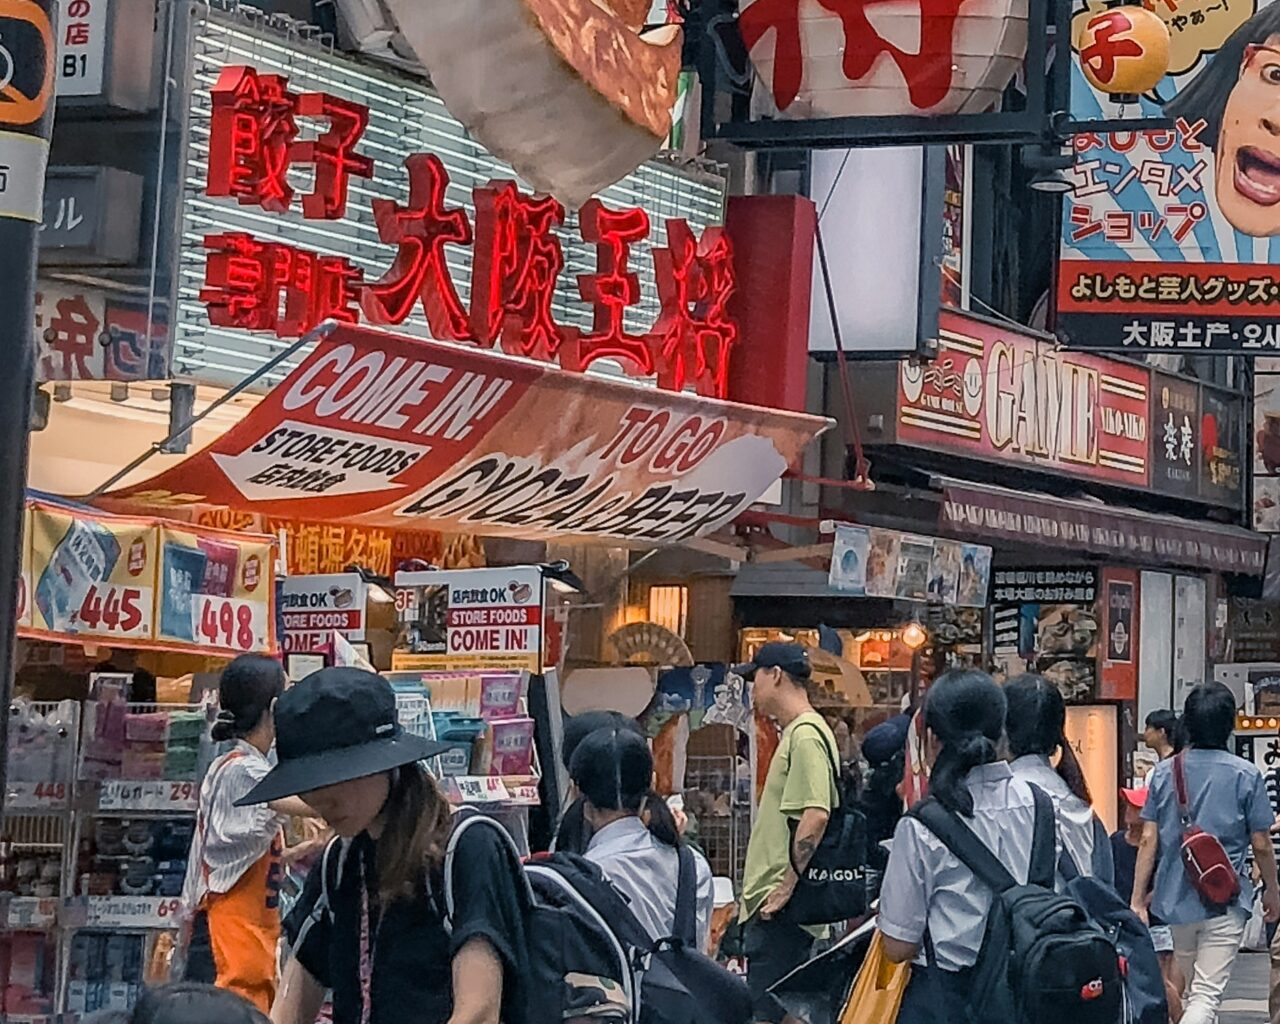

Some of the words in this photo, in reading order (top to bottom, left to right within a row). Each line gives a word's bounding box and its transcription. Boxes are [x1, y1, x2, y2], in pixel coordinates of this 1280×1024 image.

[62, 53, 89, 78] B1
[207, 66, 373, 219] 餃子
[1073, 160, 1208, 198] エンタメ
[1070, 202, 1208, 243] ショップ
[362, 154, 738, 402] 大阪王将
[282, 343, 454, 430] COME
[412, 371, 513, 442] IN!
[985, 340, 1099, 466] GAME
[252, 426, 343, 465] STORE
[338, 440, 421, 476] FOODS
[600, 407, 669, 465] TO
[651, 416, 728, 474] GO
[402, 457, 614, 529] GYOZA
[612, 483, 748, 541] BEER
[281, 613, 308, 628] ORE
[309, 612, 349, 628] FOODS
[450, 629, 501, 652] COME
[504, 628, 529, 651] IN!
[451, 611, 489, 626] STORE
[489, 608, 528, 625] FOODS
